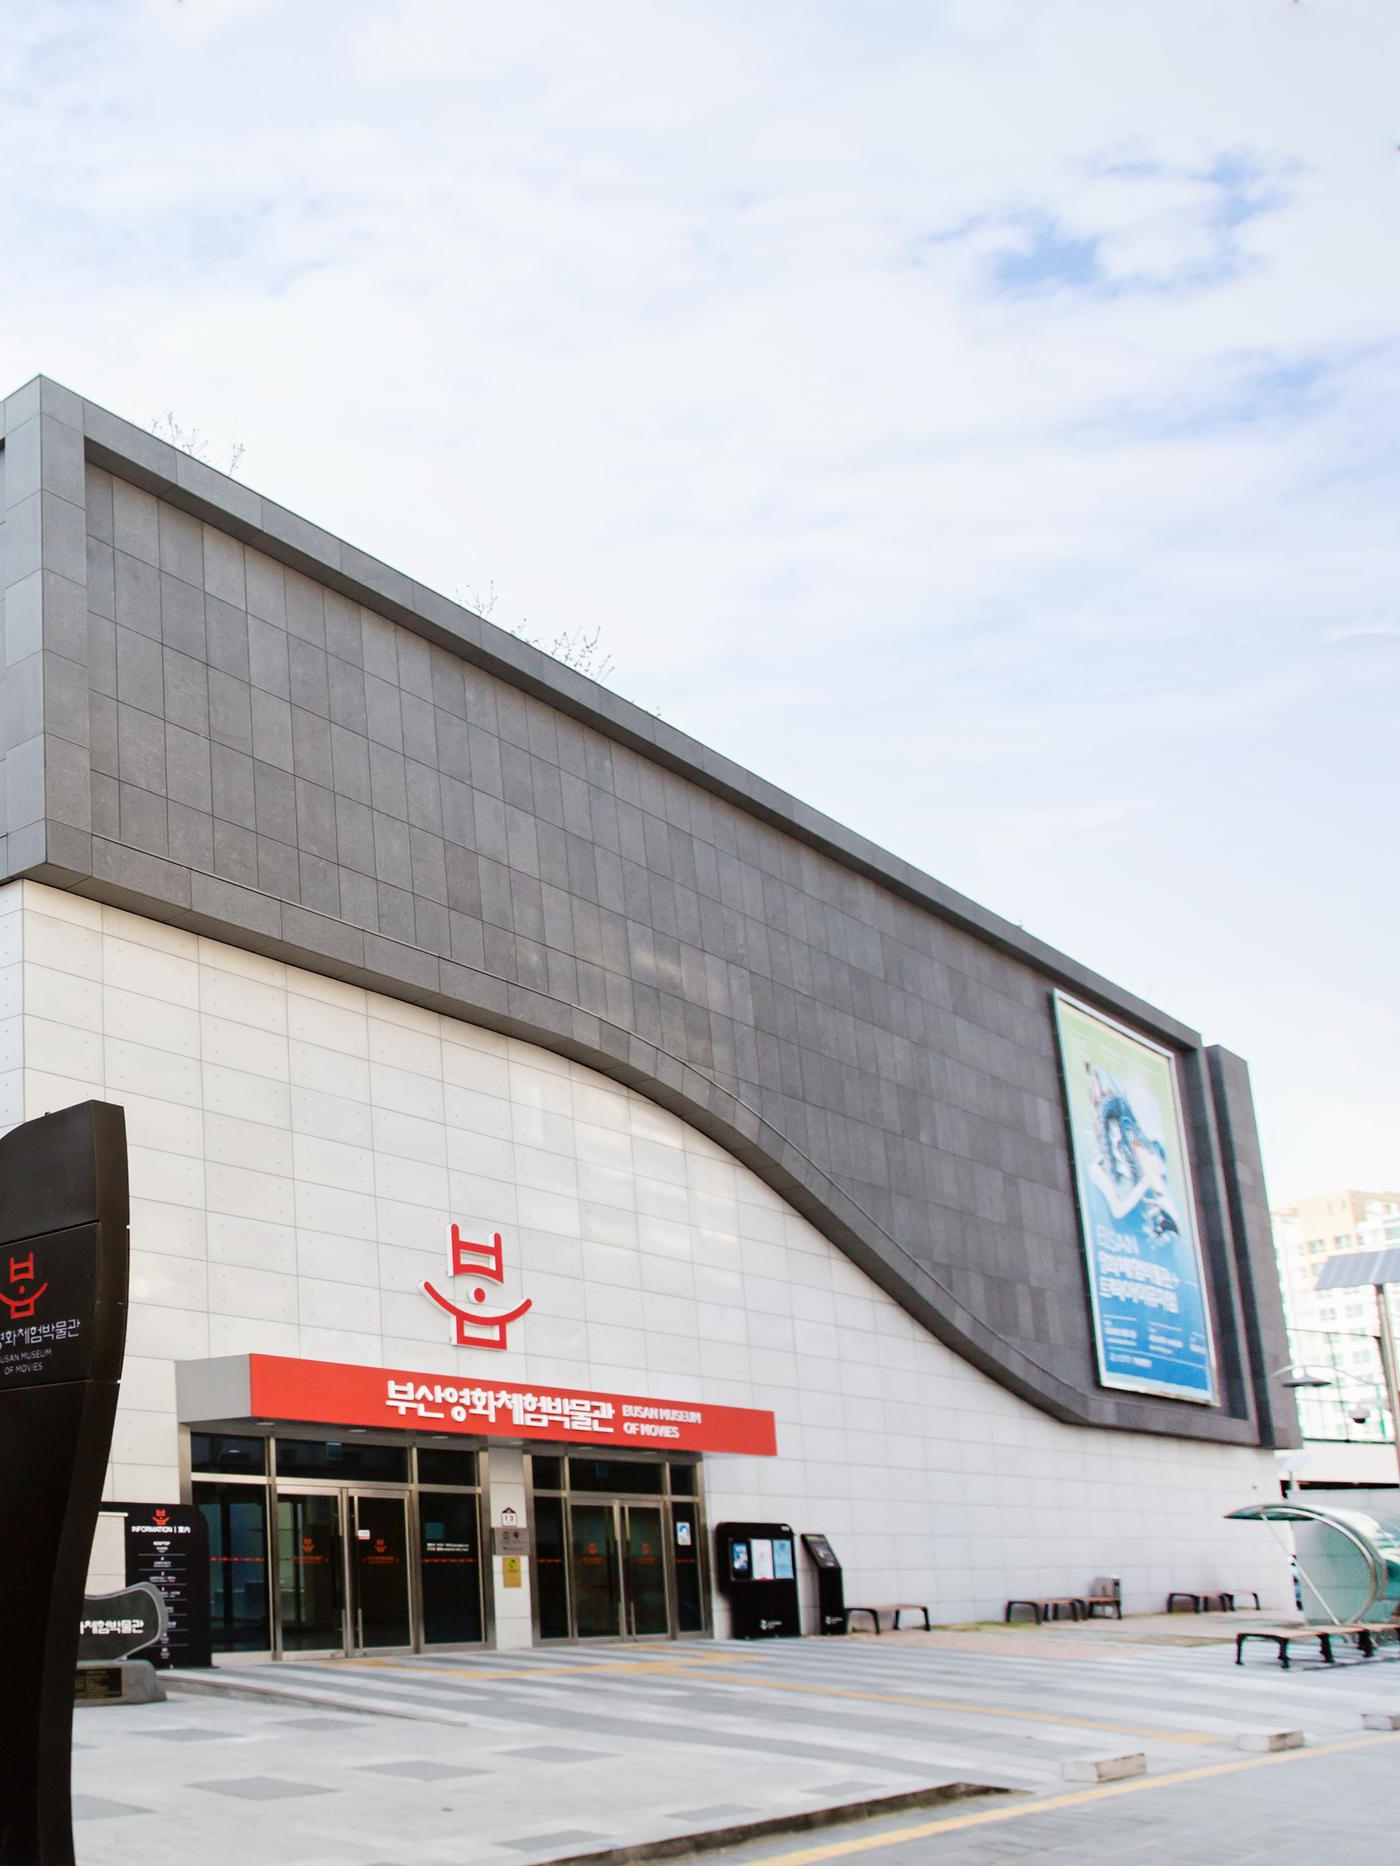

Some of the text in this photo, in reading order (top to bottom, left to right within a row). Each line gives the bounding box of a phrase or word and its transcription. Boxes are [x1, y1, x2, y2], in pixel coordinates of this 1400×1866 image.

[21, 1348, 52, 1361] MUSEUM
[4, 1361, 43, 1375] OF MOVIES
[385, 1379, 615, 1433] 부산영화체험박물관
[622, 1404, 702, 1425] BUSAN MUSEUM
[623, 1421, 680, 1439] OF MOVIES
